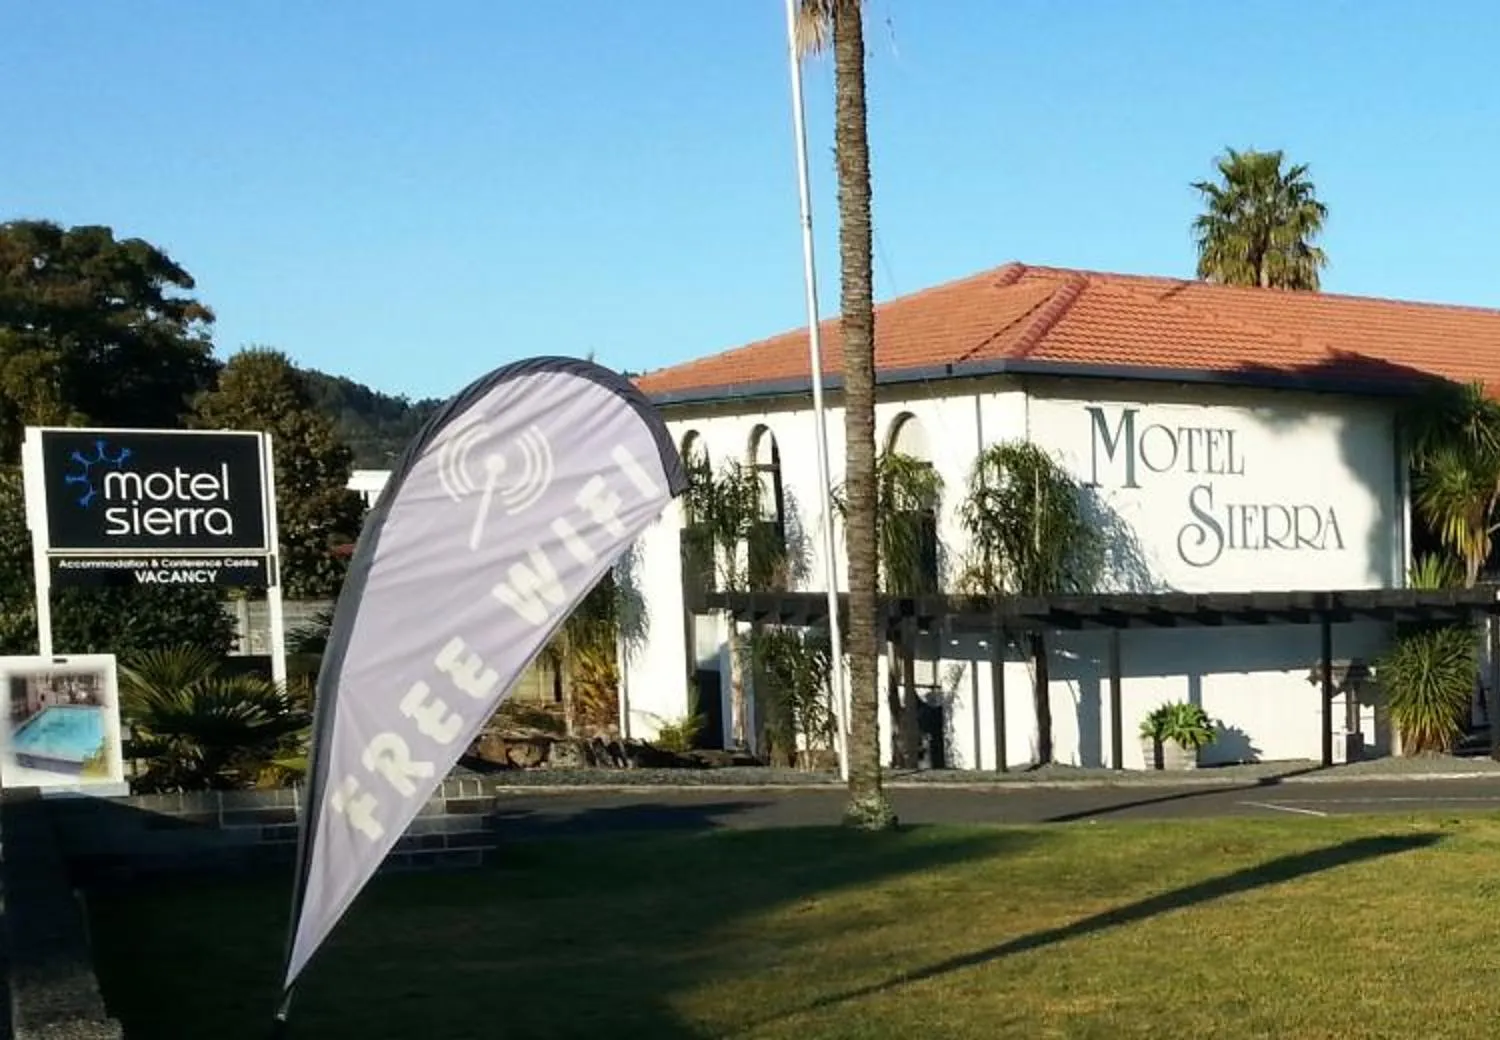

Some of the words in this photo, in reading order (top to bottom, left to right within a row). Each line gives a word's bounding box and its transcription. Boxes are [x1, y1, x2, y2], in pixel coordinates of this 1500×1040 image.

[1085, 406, 1245, 488] MOTEL
[104, 463, 229, 500] motel
[105, 500, 233, 535] sierra
[1177, 482, 1346, 568] SIERRA
[134, 569, 218, 584] VACANCY
[333, 637, 499, 841] FREE
[492, 445, 660, 625] WIFI
